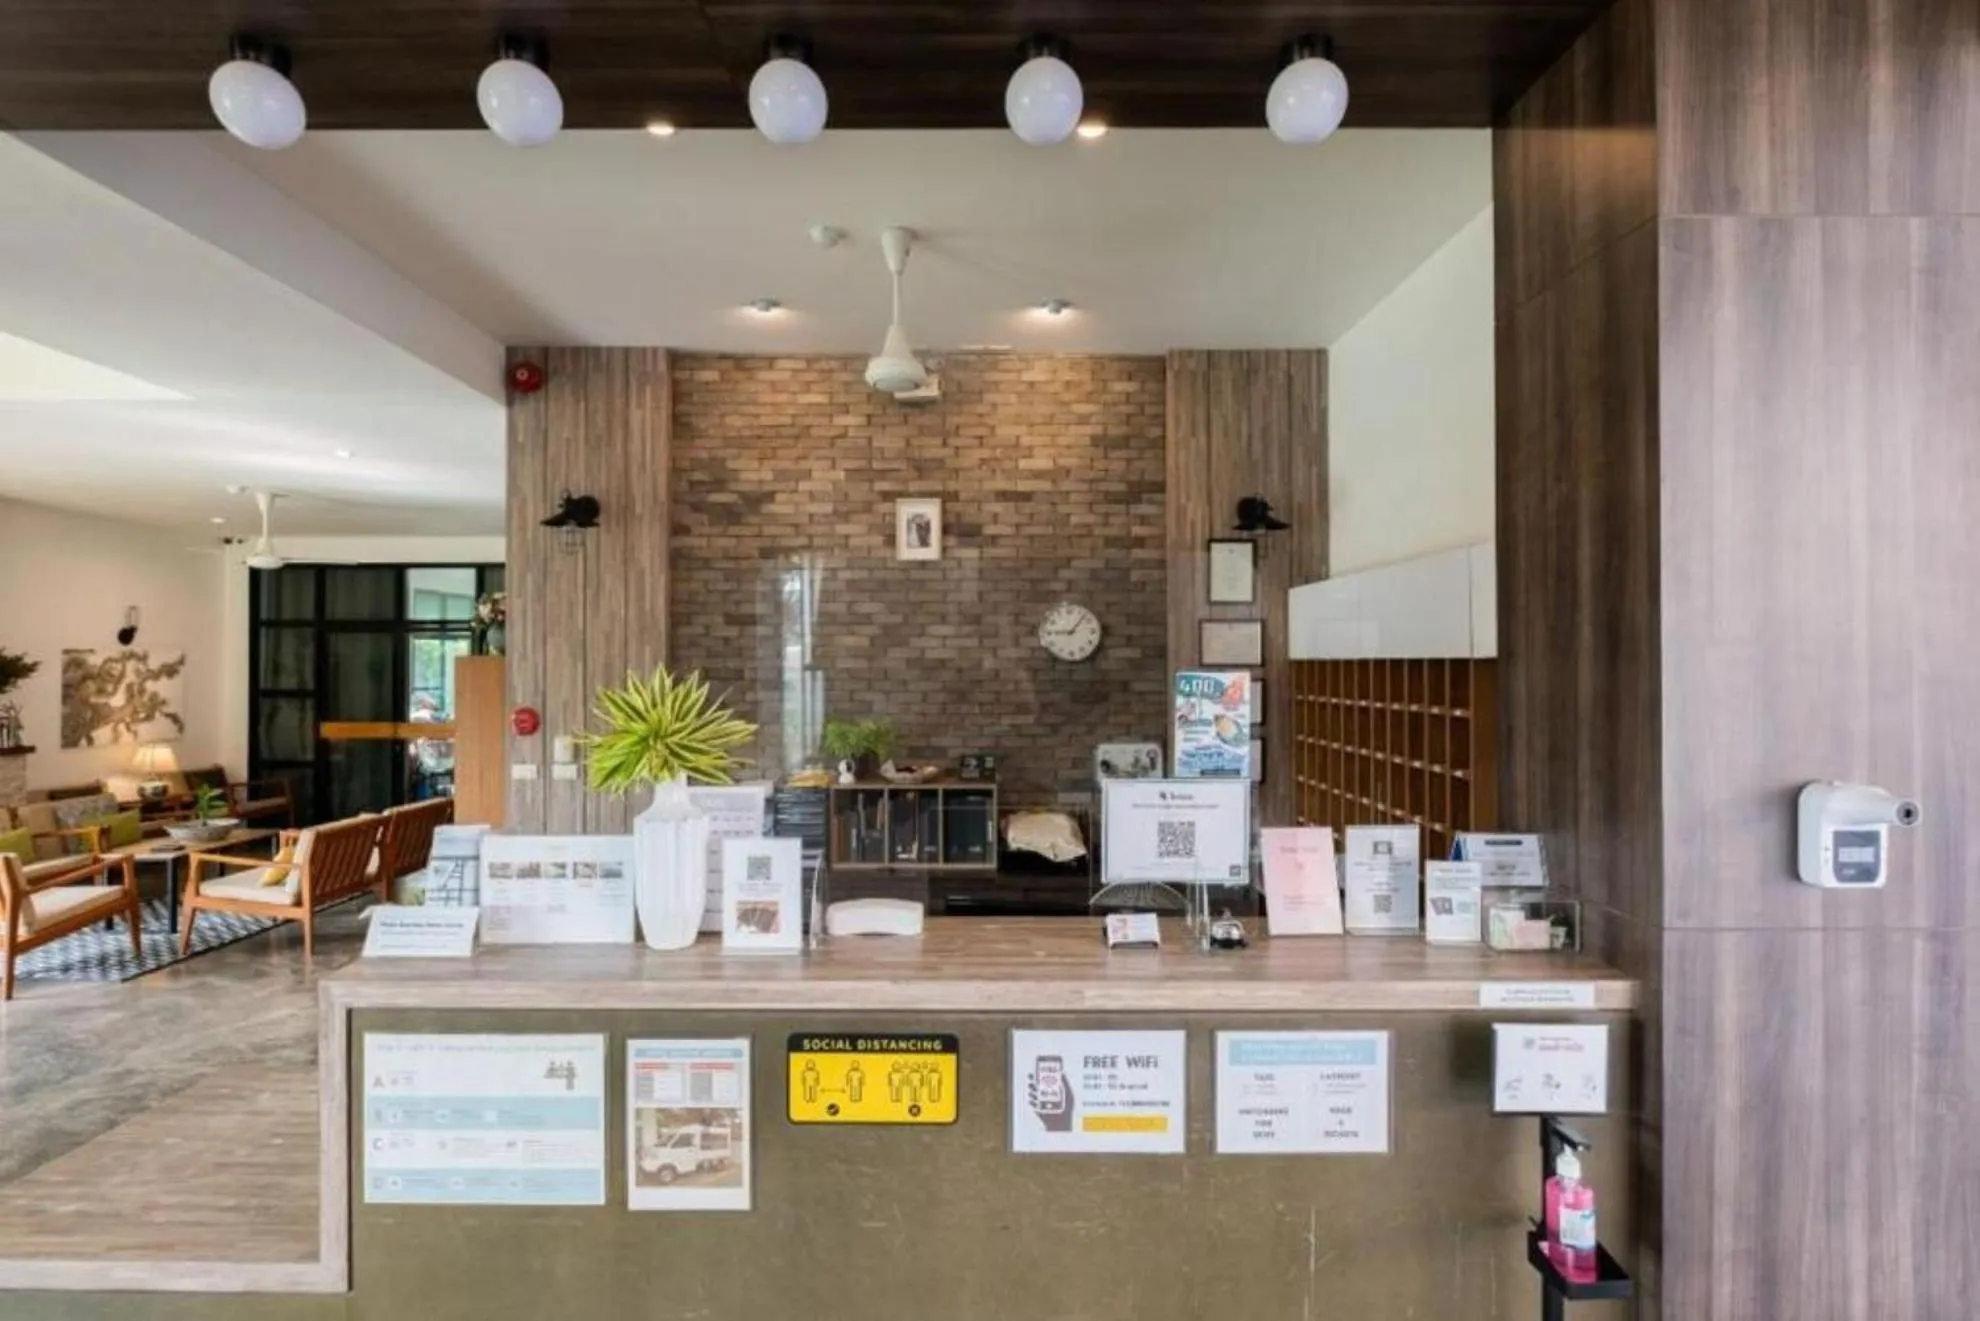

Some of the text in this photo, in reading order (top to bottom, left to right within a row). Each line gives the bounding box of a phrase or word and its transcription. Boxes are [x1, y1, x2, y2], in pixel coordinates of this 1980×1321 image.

[802, 1038, 943, 1051] SOCIAL DISTANCING
[1083, 1055, 1118, 1069] FREE
[373, 1076, 385, 1089] A
[373, 1137, 384, 1150] C
